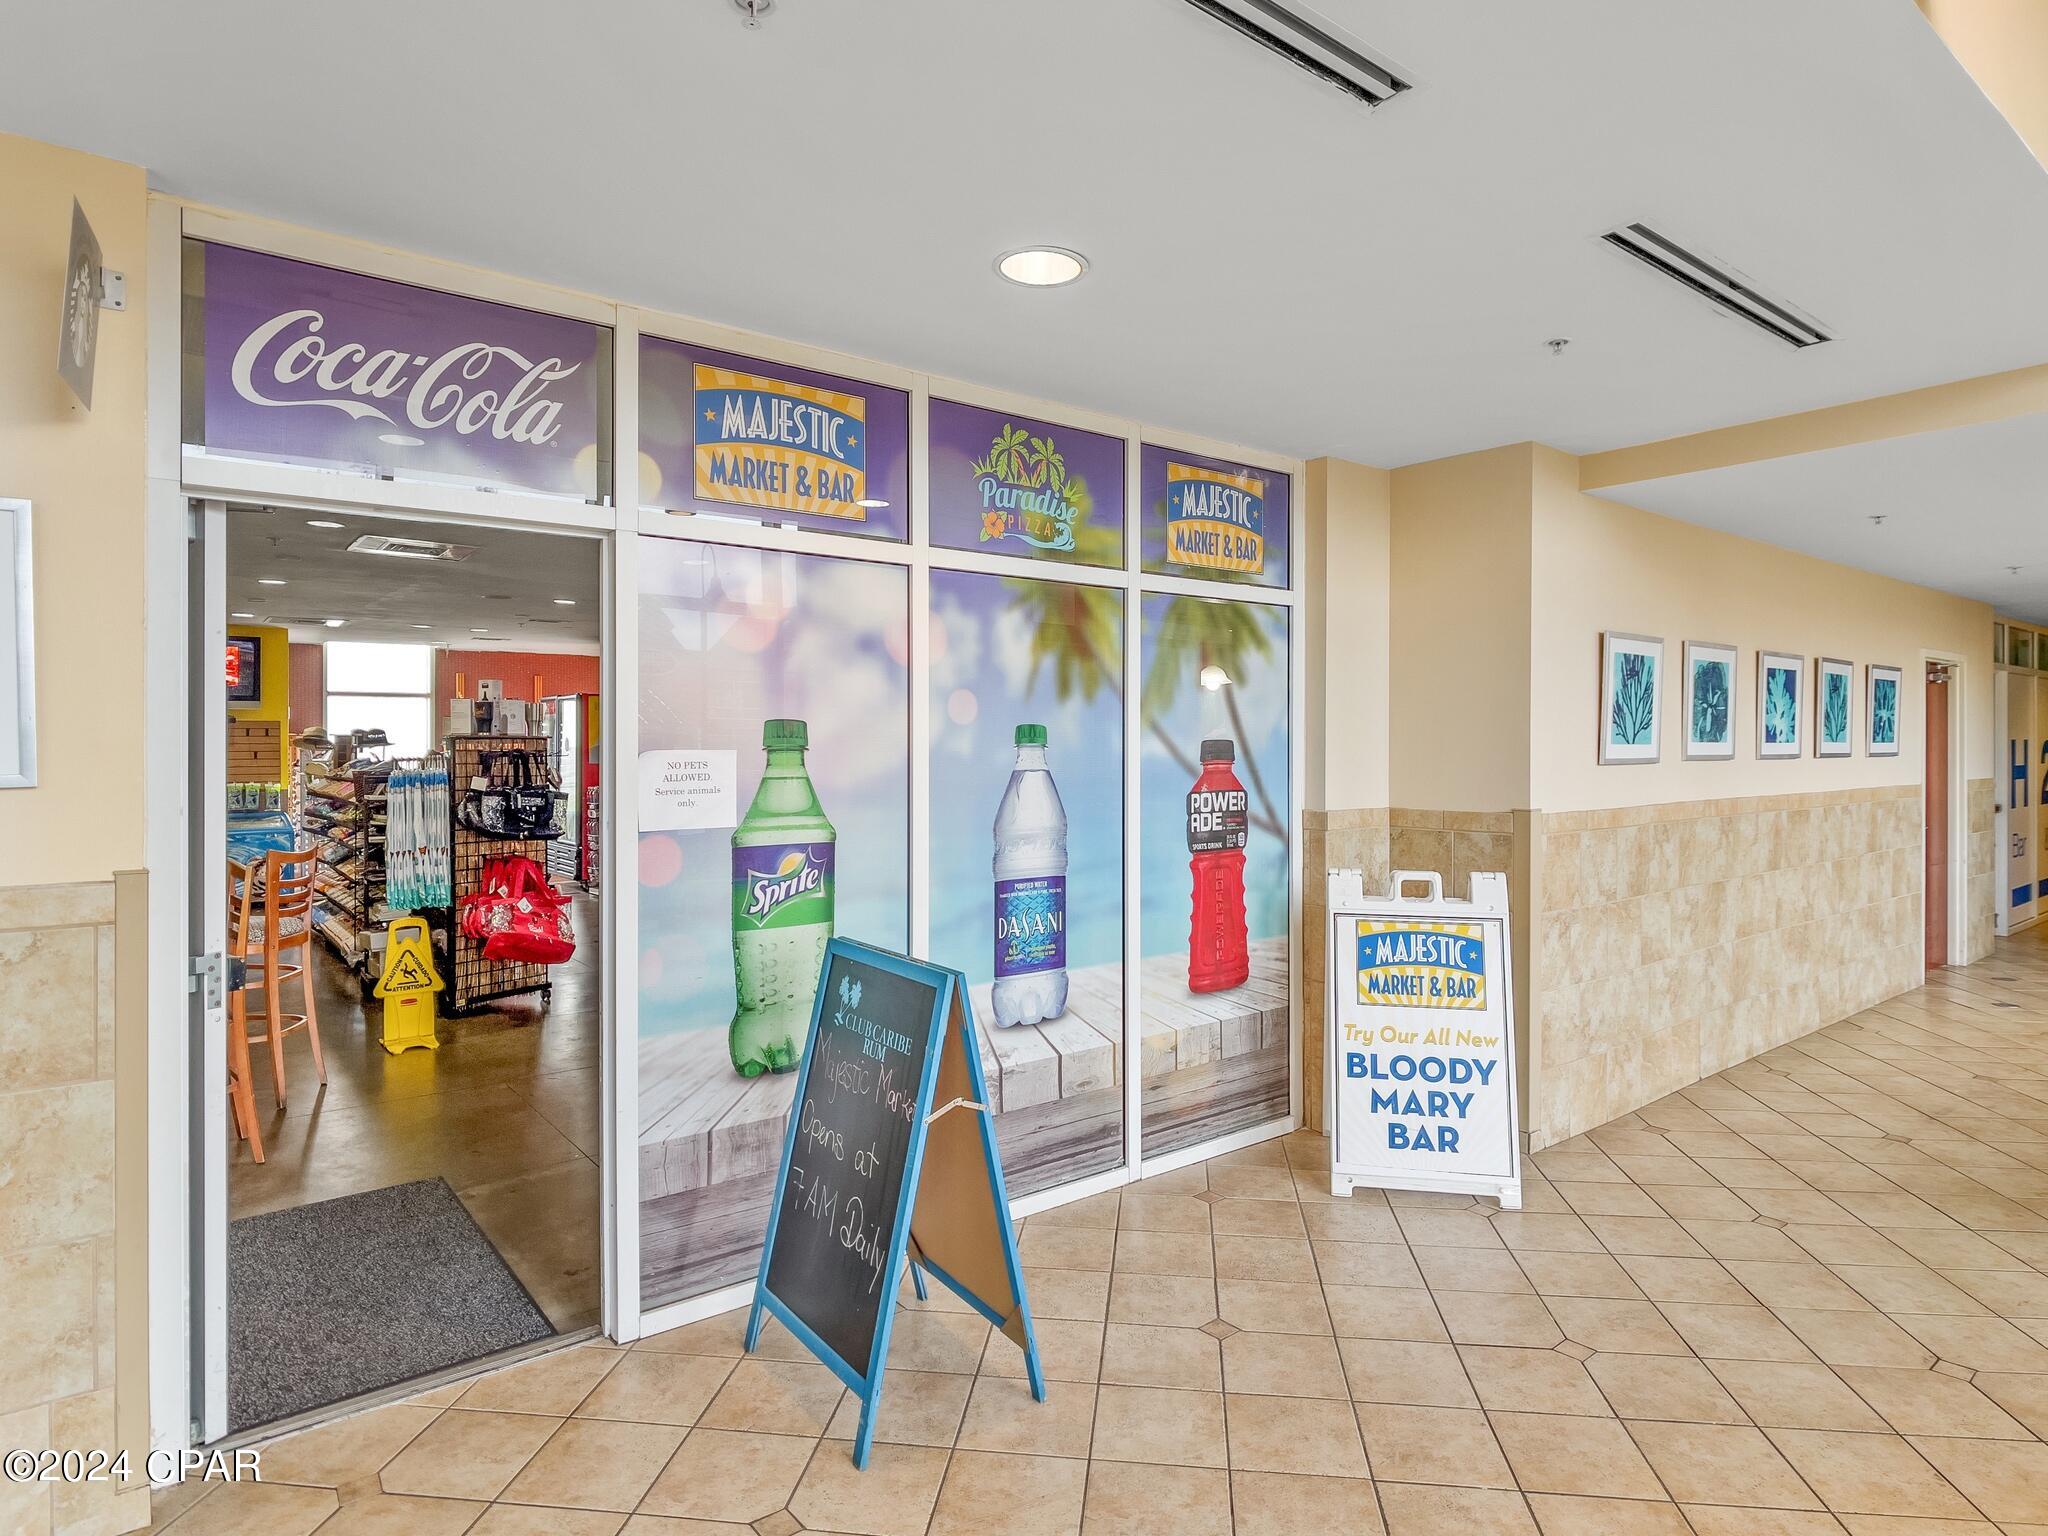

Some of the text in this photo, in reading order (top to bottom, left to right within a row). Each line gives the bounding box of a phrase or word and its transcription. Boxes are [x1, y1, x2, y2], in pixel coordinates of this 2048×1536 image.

[232, 309, 582, 446] Coca-Cola
[720, 394, 845, 459] MAJESTIC
[709, 451, 855, 504] MARKET & BAR
[978, 477, 1079, 525] Paradise
[1182, 483, 1252, 529] MAJESTIC
[1008, 514, 1051, 537] PIZZA
[1175, 527, 1257, 562] MARKET & BAR
[667, 760, 709, 770] NO PETS
[655, 785, 721, 796] Service animals
[1191, 791, 1246, 813] POWER
[748, 861, 819, 919] Sprite
[998, 907, 1062, 944] DASANI
[1375, 934, 1468, 969] MAJESTIC
[386, 959, 402, 982] CAUTION
[1368, 974, 1477, 999] MARKET & BAR
[392, 984, 425, 992] ATTENTION
[845, 1013, 913, 1056] CLUB CARIBE
[862, 1037, 887, 1063] RUM
[1343, 1023, 1500, 1048] Try Our All New
[1346, 1052, 1498, 1086] BLOODY
[1370, 1087, 1475, 1119] MARY
[802, 1099, 880, 1179] Opens at
[1388, 1122, 1460, 1154] BAR
[840, 1196, 886, 1295] Daily
